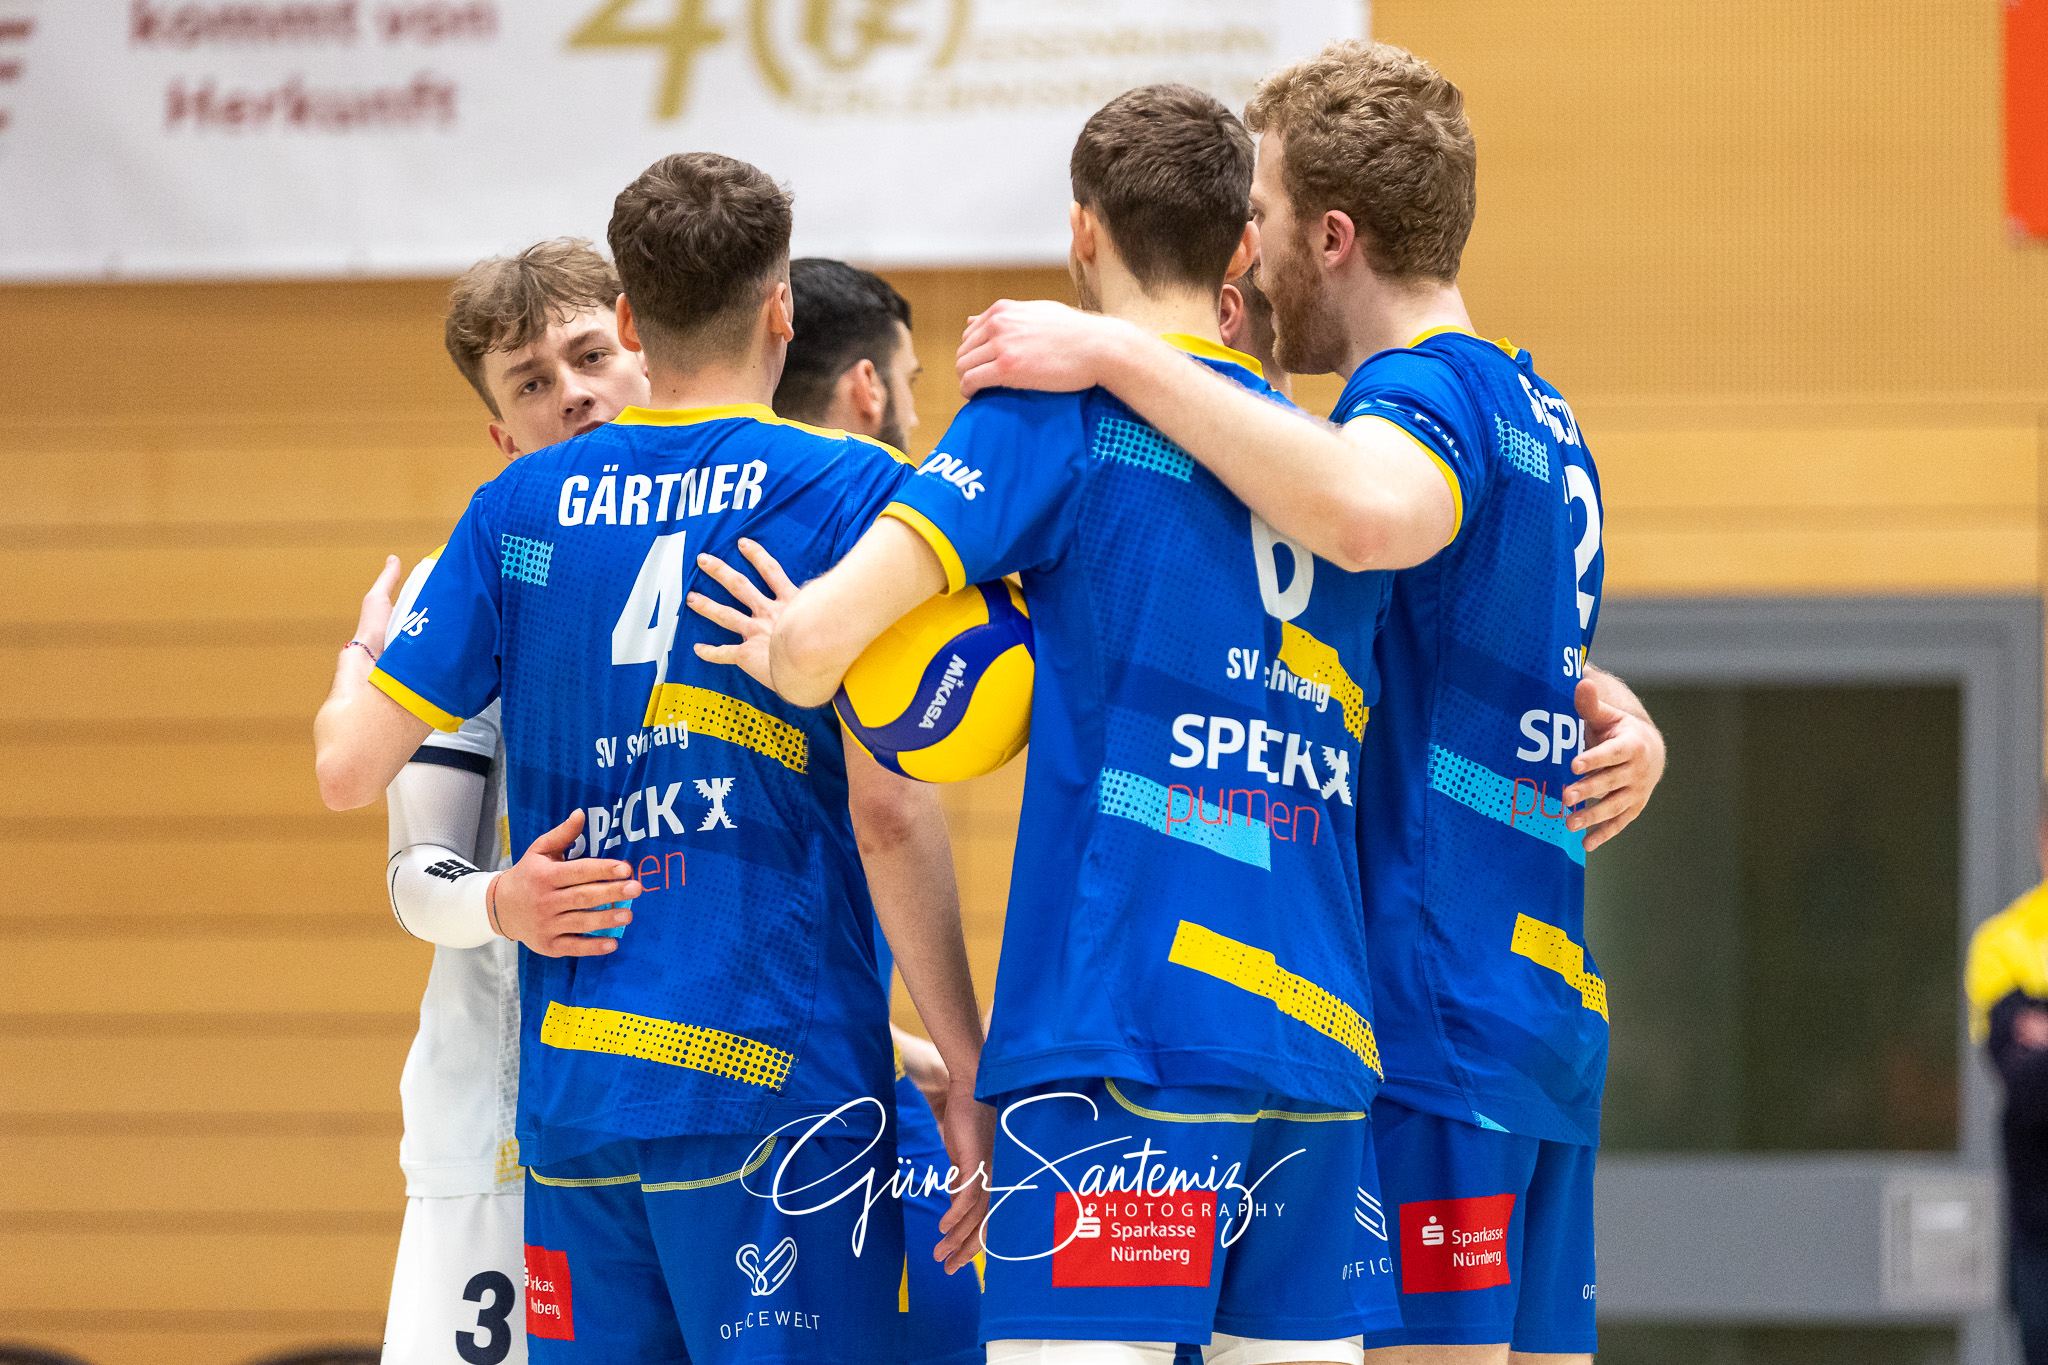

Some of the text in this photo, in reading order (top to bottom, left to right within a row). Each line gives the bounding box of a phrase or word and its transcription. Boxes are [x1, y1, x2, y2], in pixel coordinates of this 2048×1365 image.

[558, 459, 768, 527] GÄRTNER
[915, 452, 985, 501] puls
[611, 530, 687, 689] 4
[1226, 647, 1260, 680] SV
[595, 736, 618, 768] SV
[1166, 784, 1321, 846] pumen
[1110, 1221, 1197, 1242] Sparkasse
[1451, 1226, 1504, 1248] Sparkasse
[1110, 1245, 1191, 1265] Nürnberg
[1453, 1249, 1502, 1267] Nürnberg
[455, 1270, 516, 1365] 3
